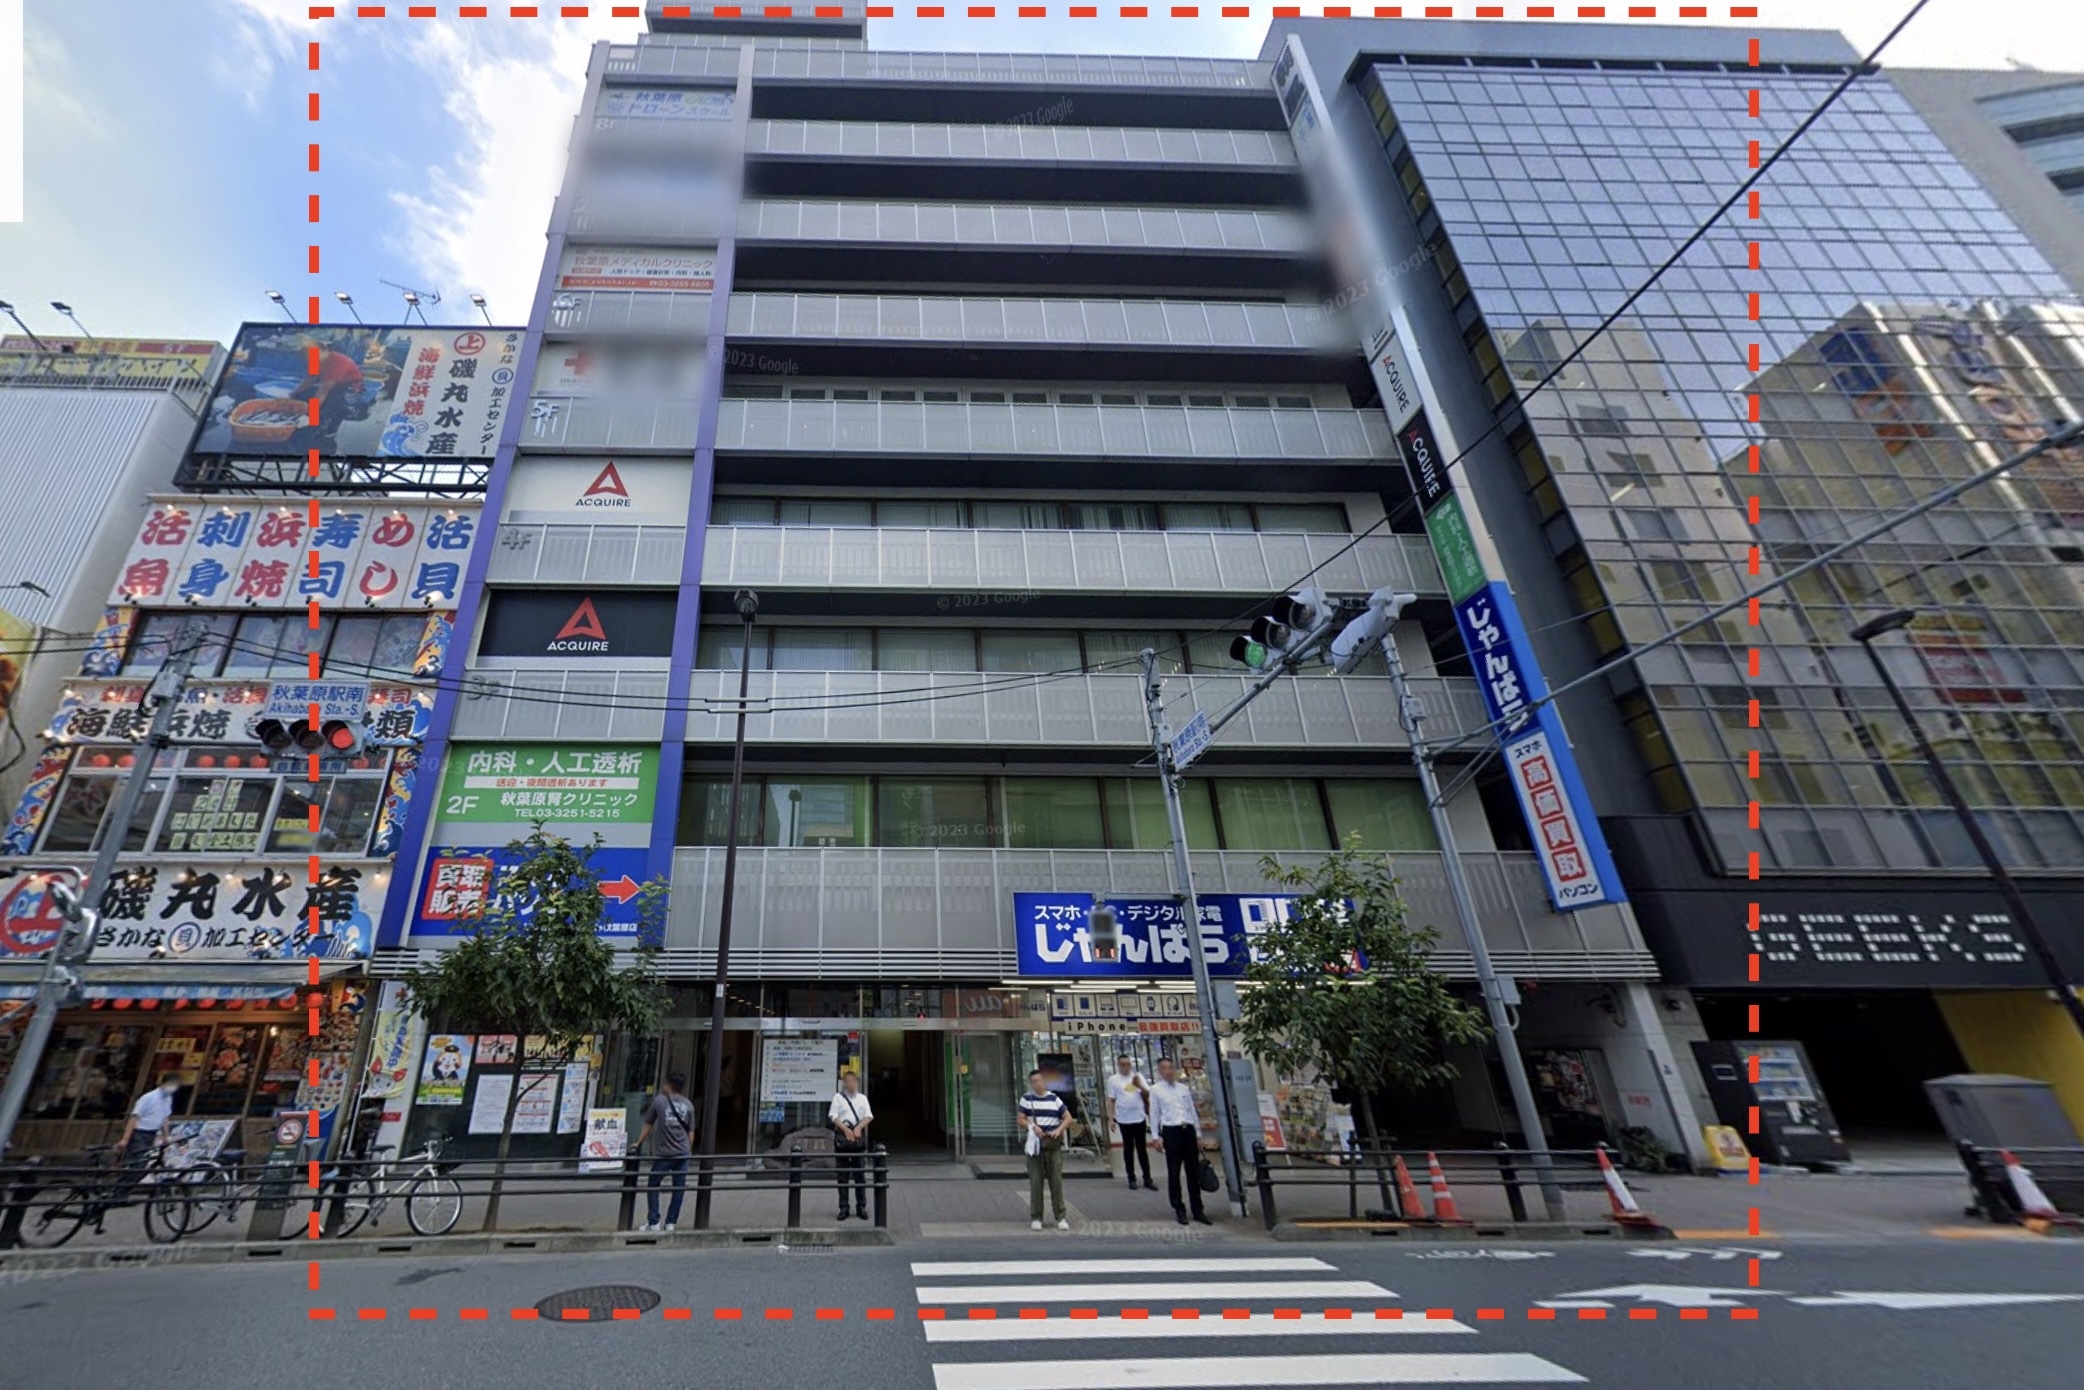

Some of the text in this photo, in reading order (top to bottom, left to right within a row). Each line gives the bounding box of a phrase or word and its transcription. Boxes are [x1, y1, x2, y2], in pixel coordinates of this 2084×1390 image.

[425, 358, 478, 455] 磯丸水産
[1382, 354, 1411, 414] ACQUIRE
[1408, 429, 1441, 499] ACQUIRE
[575, 498, 632, 508] ACQUIRE
[117, 510, 194, 598] 活魚
[177, 511, 252, 599] 刺身
[234, 512, 306, 599] 浜焼
[359, 515, 415, 598] めし
[411, 514, 475, 600] 活貝
[546, 640, 610, 651] ACQUIRE
[267, 703, 321, 716] Akihaba
[273, 685, 365, 703] 秋葉原駅南
[466, 750, 643, 775] 内科・人工透析
[446, 795, 480, 815] 2F
[500, 791, 639, 807] 秋葉原腎クリニック
[101, 867, 363, 921] 磯丸水産
[594, 1117, 618, 1130] 献血
